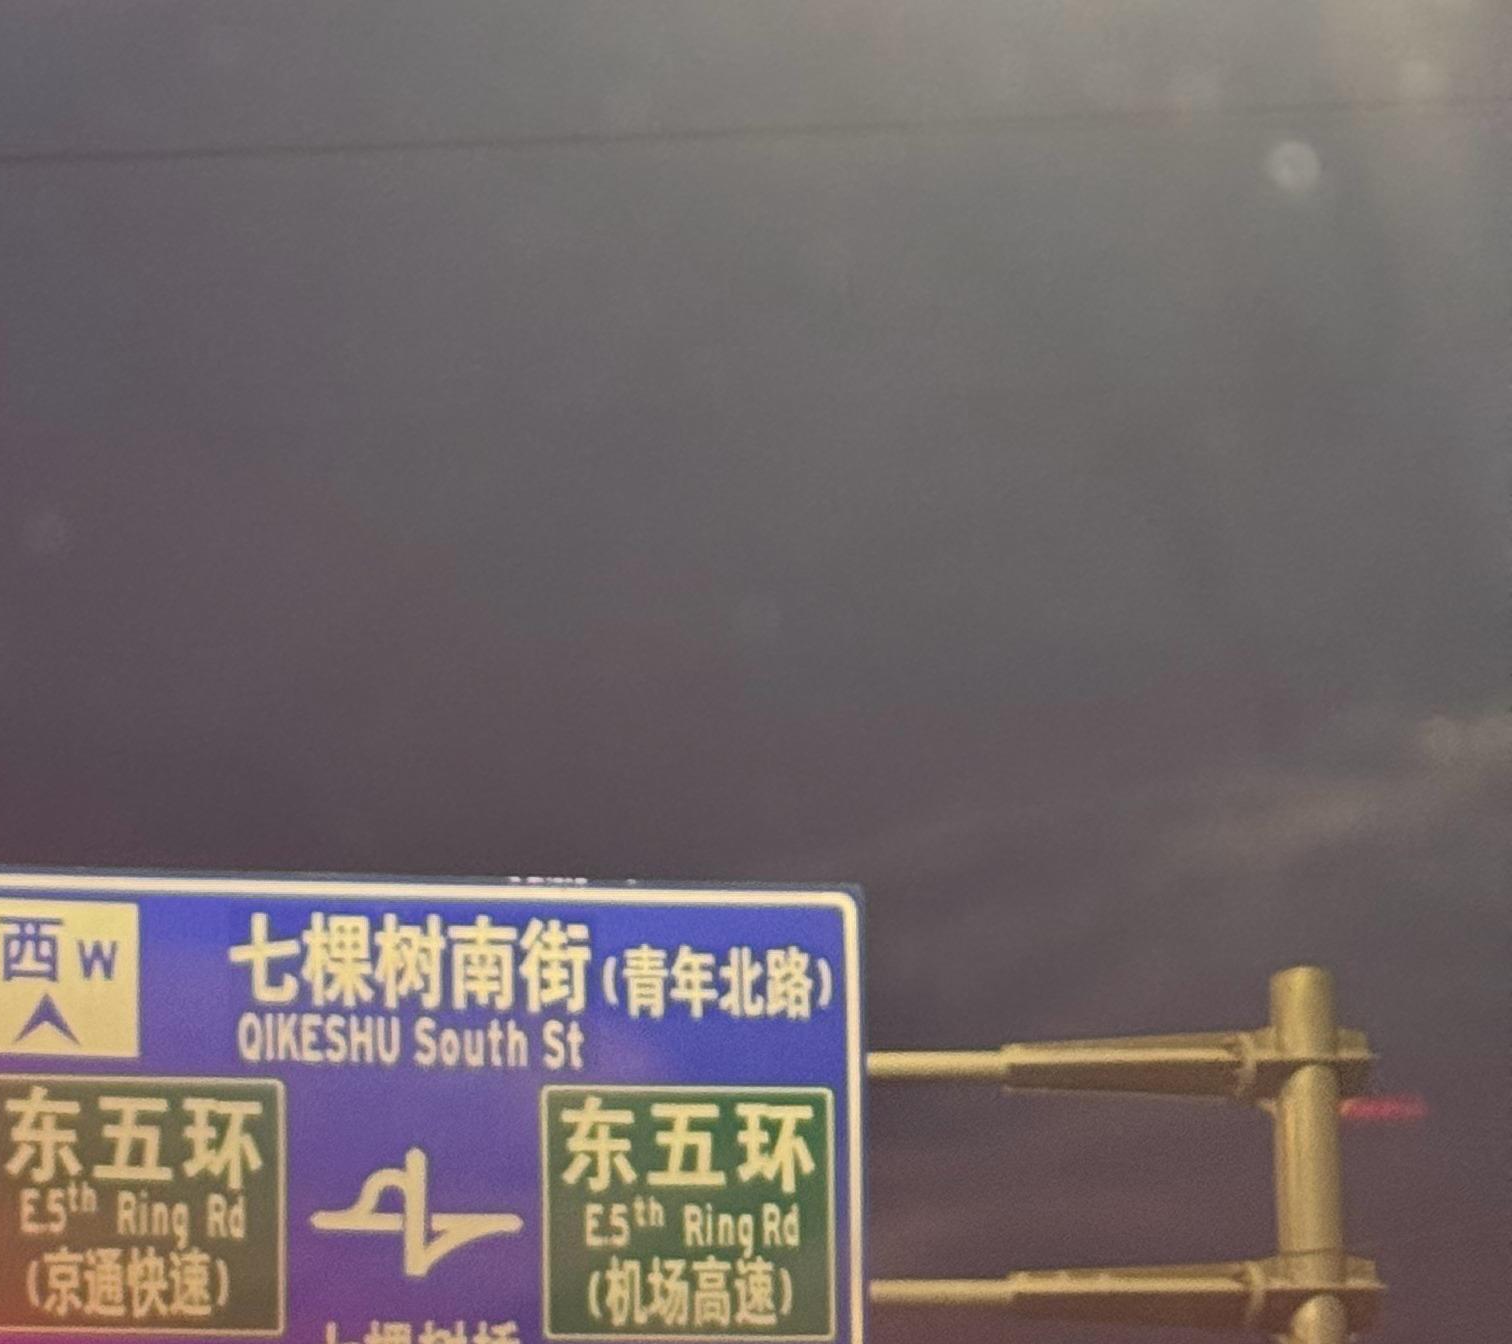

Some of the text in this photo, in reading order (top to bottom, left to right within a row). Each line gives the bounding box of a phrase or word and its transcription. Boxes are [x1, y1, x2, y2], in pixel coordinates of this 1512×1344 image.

[76, 938, 120, 981] W
[228, 911, 833, 1021] 七棵树南街 (青年北路)
[237, 1013, 585, 1070] QIKESHU South St
[4, 1085, 264, 1190] 东五环
[560, 1096, 816, 1194] 东五环
[116, 1190, 190, 1251] Ring
[206, 1193, 247, 1240] Rd
[683, 1203, 755, 1259] Ring
[762, 1202, 801, 1248] Rd
[26, 1246, 230, 1319] (京通快速)
[588, 1255, 794, 1327] (机场高速)
